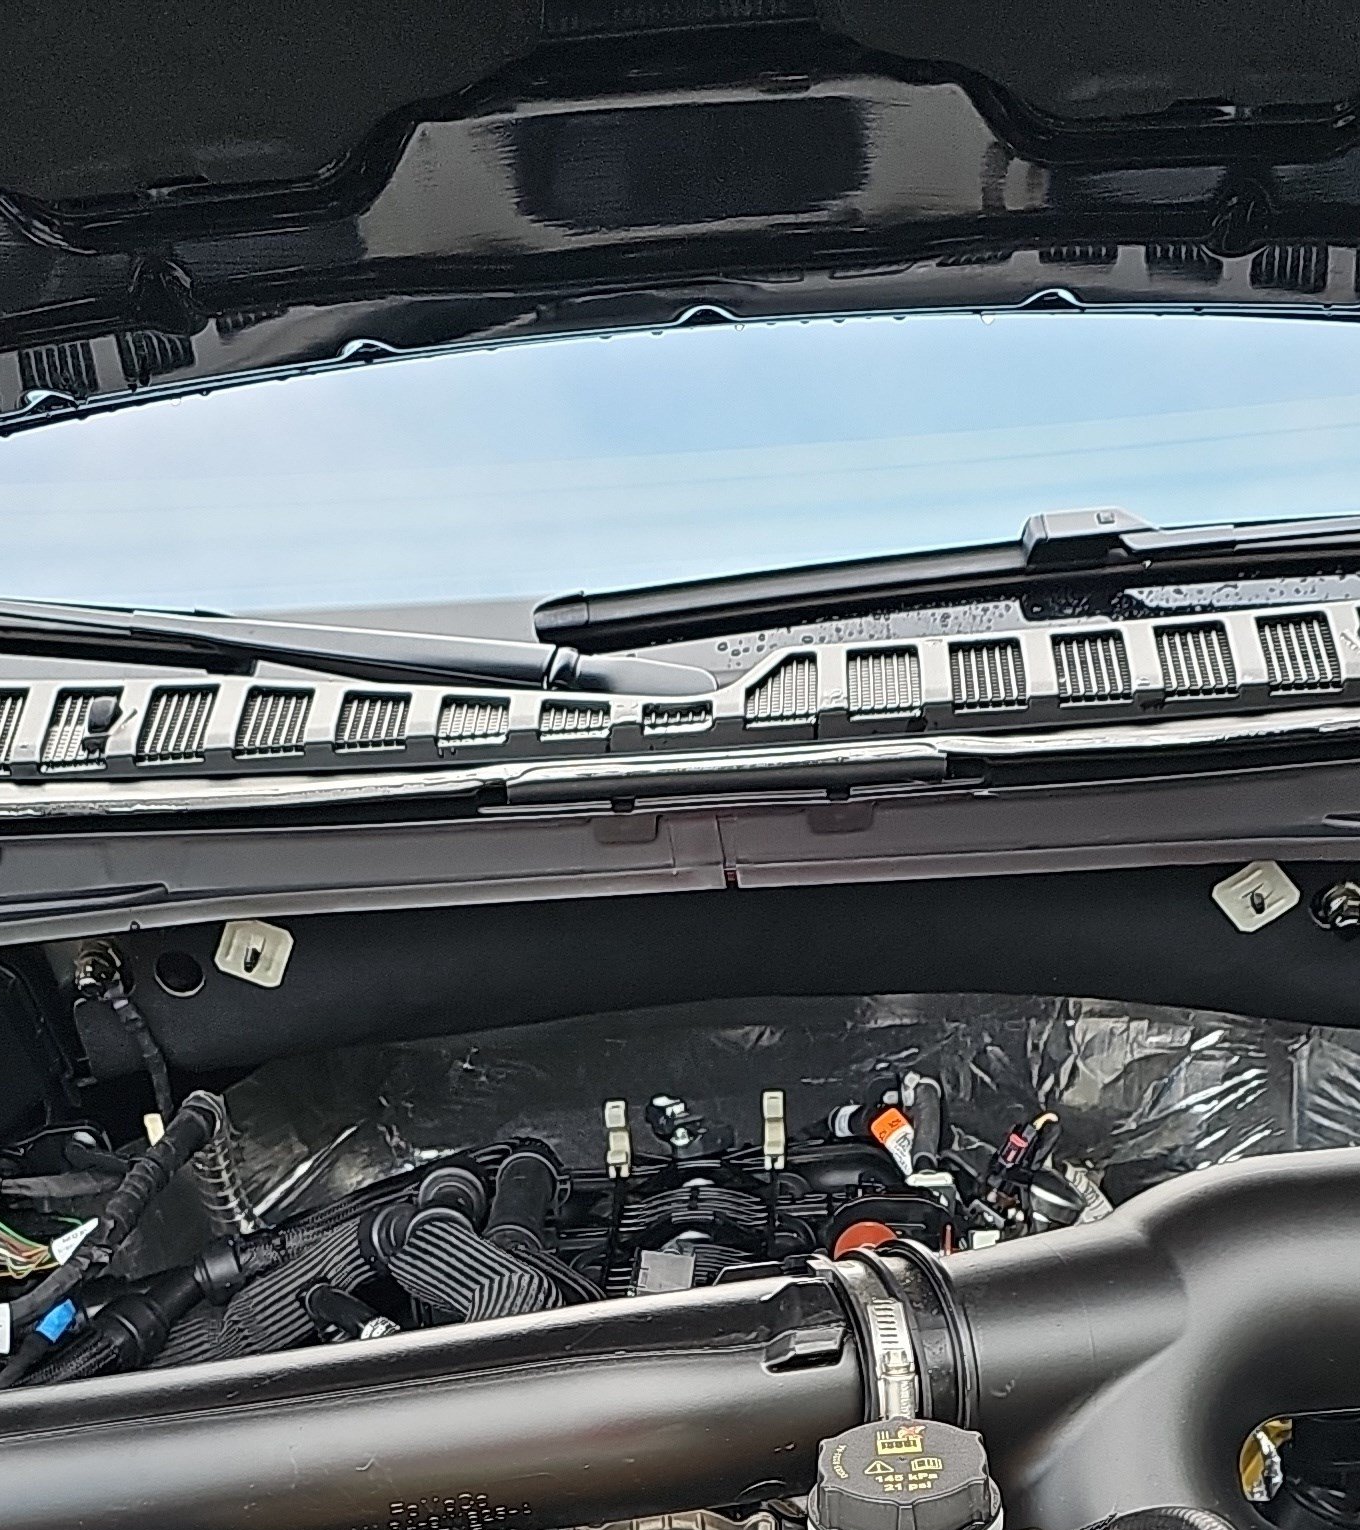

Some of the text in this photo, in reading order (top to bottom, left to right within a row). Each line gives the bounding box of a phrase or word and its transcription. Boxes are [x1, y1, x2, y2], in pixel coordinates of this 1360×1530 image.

[908, 1472, 938, 1482] kPa
[883, 1481, 932, 1492] 21 psi
